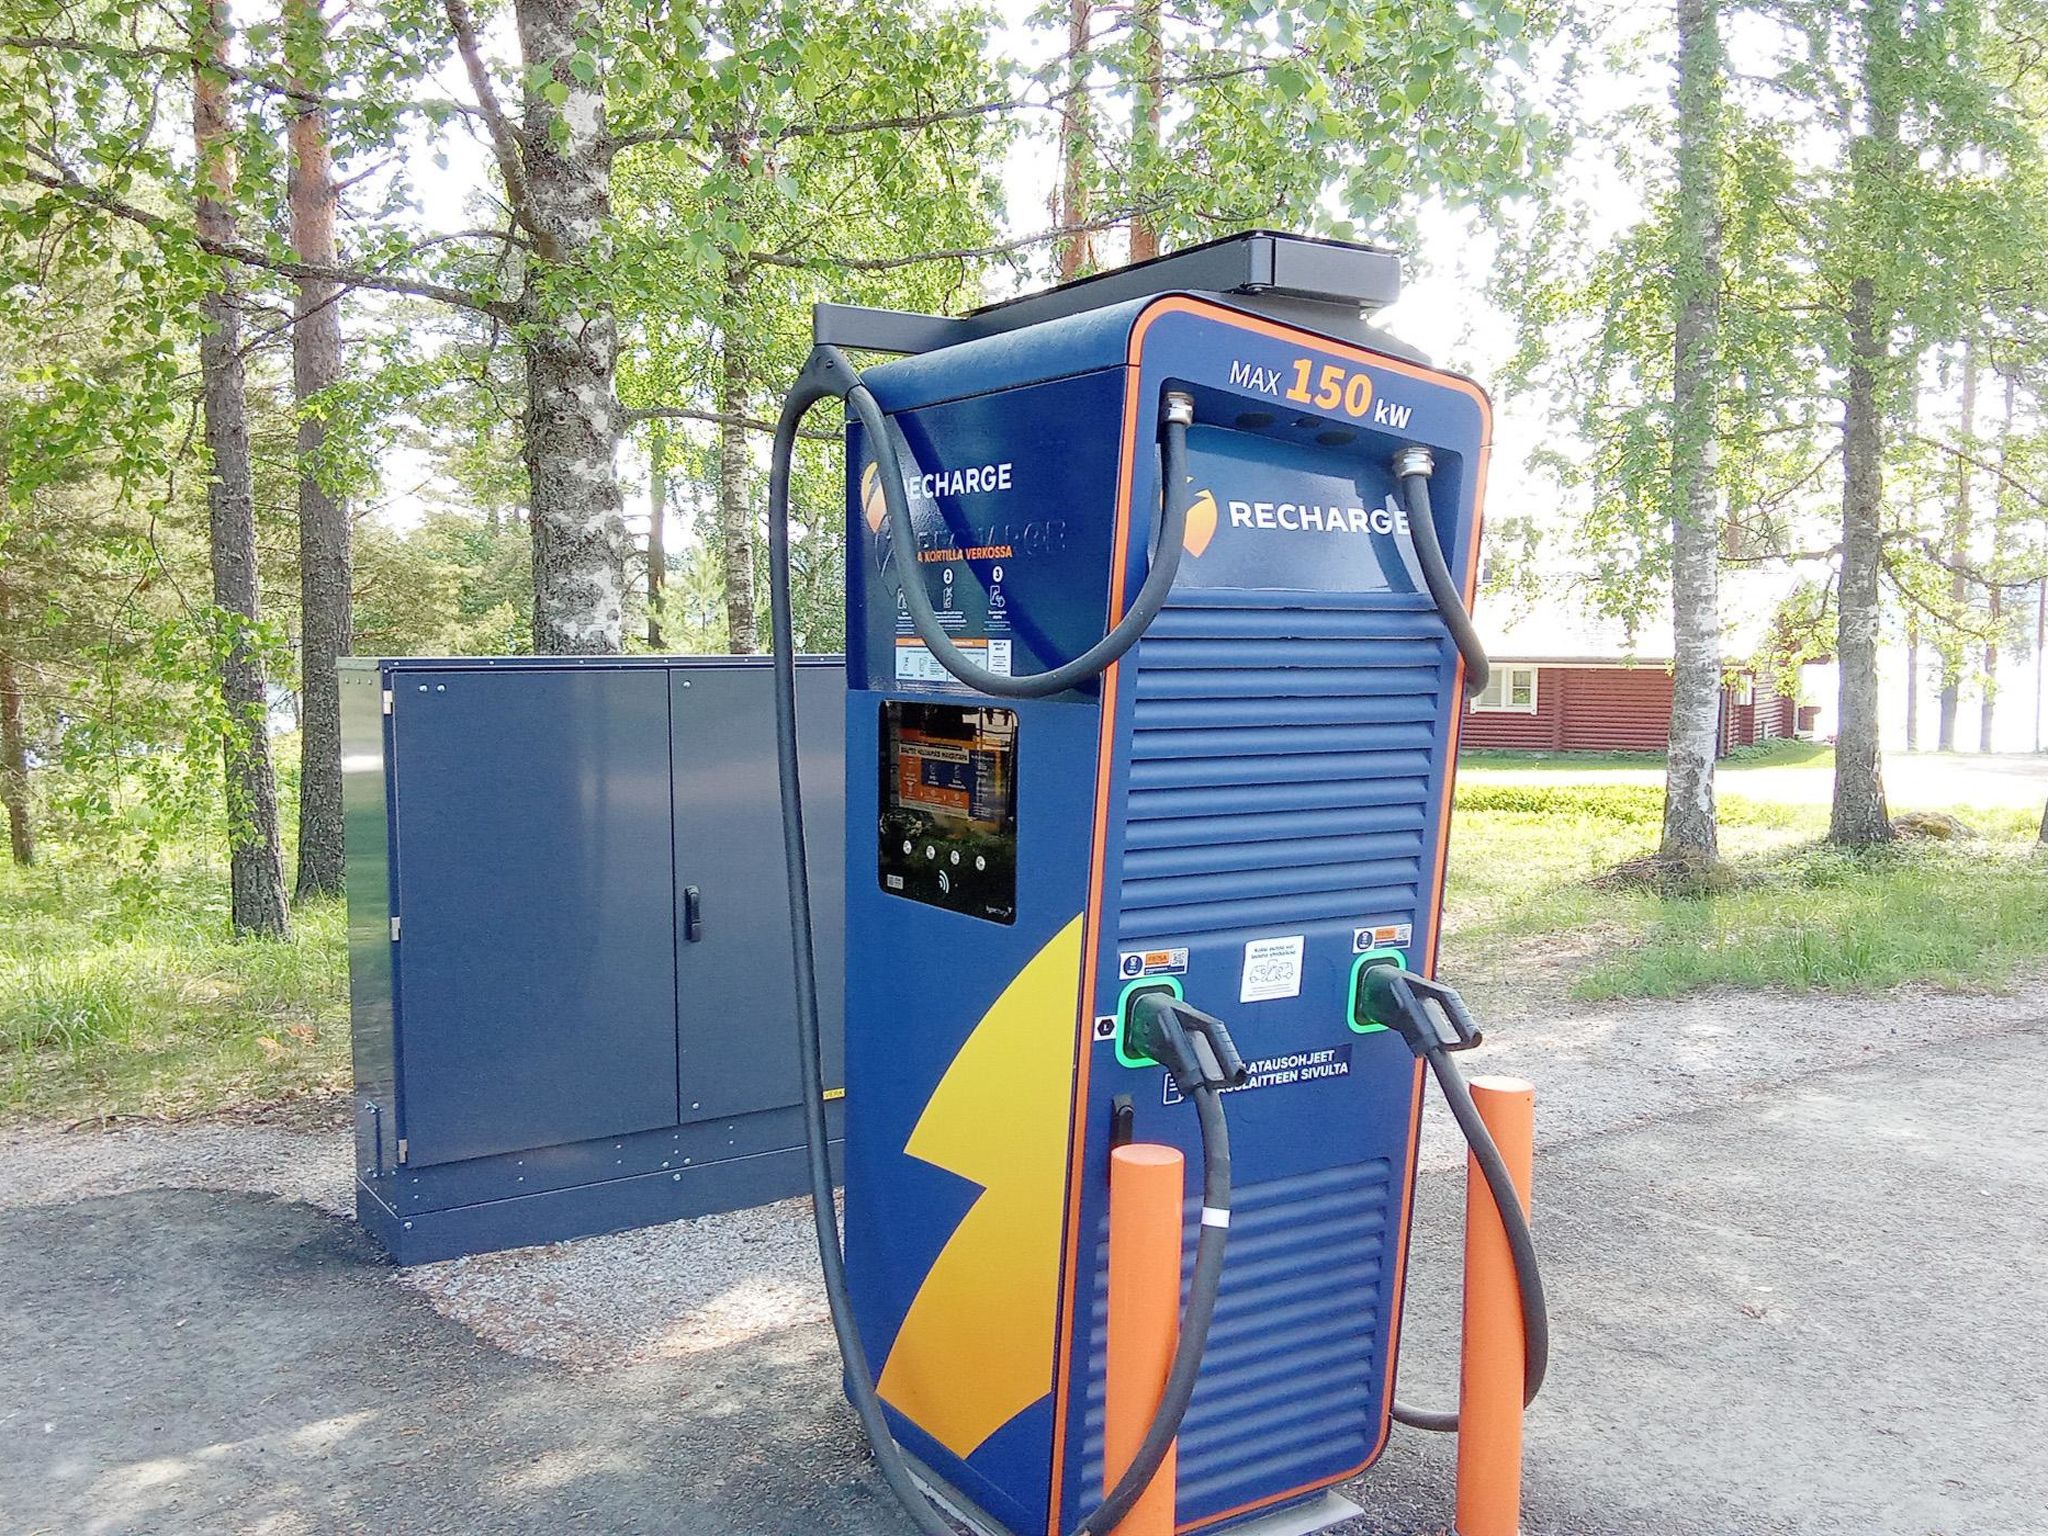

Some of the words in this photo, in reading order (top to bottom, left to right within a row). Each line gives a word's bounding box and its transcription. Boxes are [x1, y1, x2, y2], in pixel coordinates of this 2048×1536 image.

[1229, 360, 1281, 396] MAX
[1286, 358, 1373, 418] 150
[1374, 398, 1412, 430] kW
[904, 463, 1012, 500] ECHARGE
[1228, 501, 1411, 535] RECHARGE
[924, 548, 963, 562] KORTILLA
[965, 545, 1013, 560] VERKOSSA
[1301, 1062, 1348, 1080] SIVULTA
